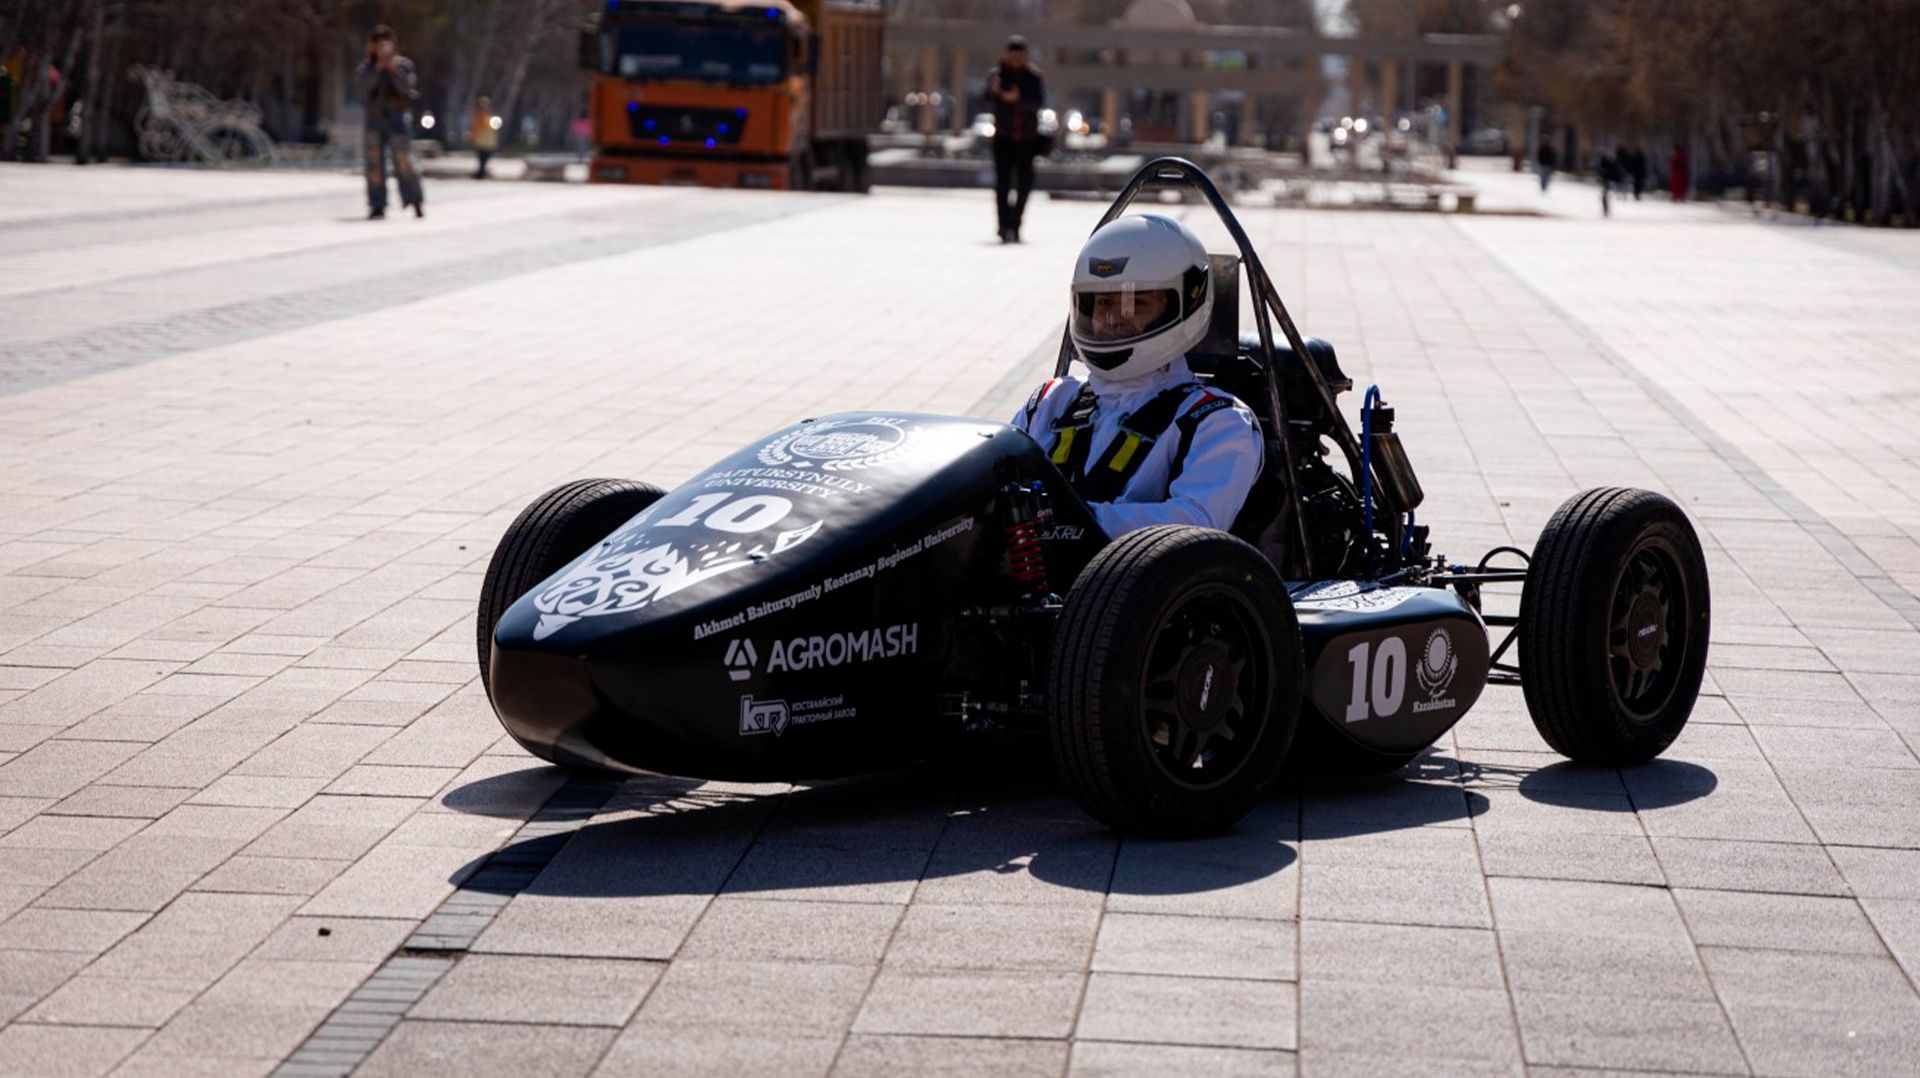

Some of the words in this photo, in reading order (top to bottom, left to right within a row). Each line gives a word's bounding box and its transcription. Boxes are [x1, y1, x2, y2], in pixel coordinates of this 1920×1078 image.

[704, 467, 872, 494] BAITURSYNULY
[704, 477, 837, 498] UNIVERSITY
[653, 492, 793, 533] 10
[694, 611, 746, 640] Akhmet
[746, 584, 822, 621] Baitursynuly
[823, 563, 876, 593] Kostanay
[877, 539, 922, 571] Regional
[924, 516, 974, 548] University
[766, 622, 918, 673] AGROMASH
[1345, 636, 1408, 723] 10
[1412, 698, 1456, 713] Kazakhstan
